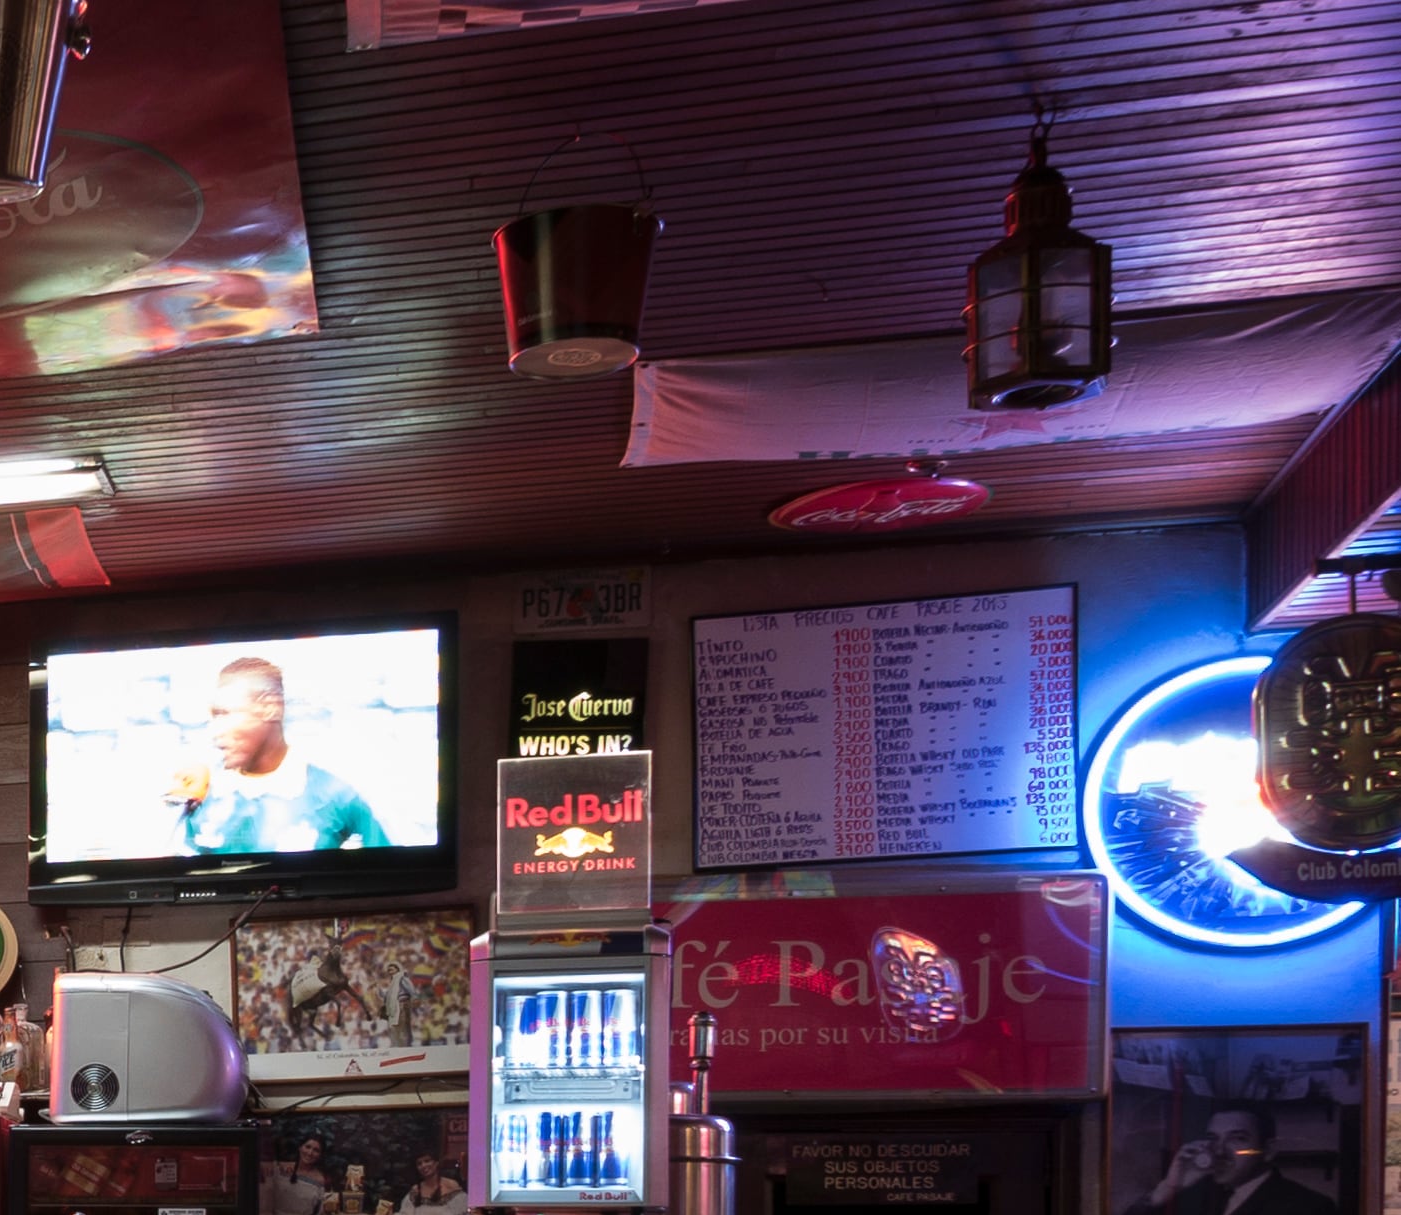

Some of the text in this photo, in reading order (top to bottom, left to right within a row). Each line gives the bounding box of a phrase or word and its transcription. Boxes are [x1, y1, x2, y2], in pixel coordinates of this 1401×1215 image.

[791, 492, 979, 527] Coca-Cola
[523, 583, 642, 618] P67 3BR
[520, 691, 636, 722] Jose Cuervo
[518, 734, 633, 756] WHO'S IN?
[505, 791, 643, 829] Red Bull
[512, 856, 636, 874] ENERGY DRINK
[1298, 862, 1336, 881] Club
[759, 1019, 939, 1052] por su visita
[792, 1143, 972, 1159] FAVOR NO DESCUIDAR
[824, 1159, 940, 1175] SUS OBJETOS
[824, 1176, 935, 1190] PERSONALES
